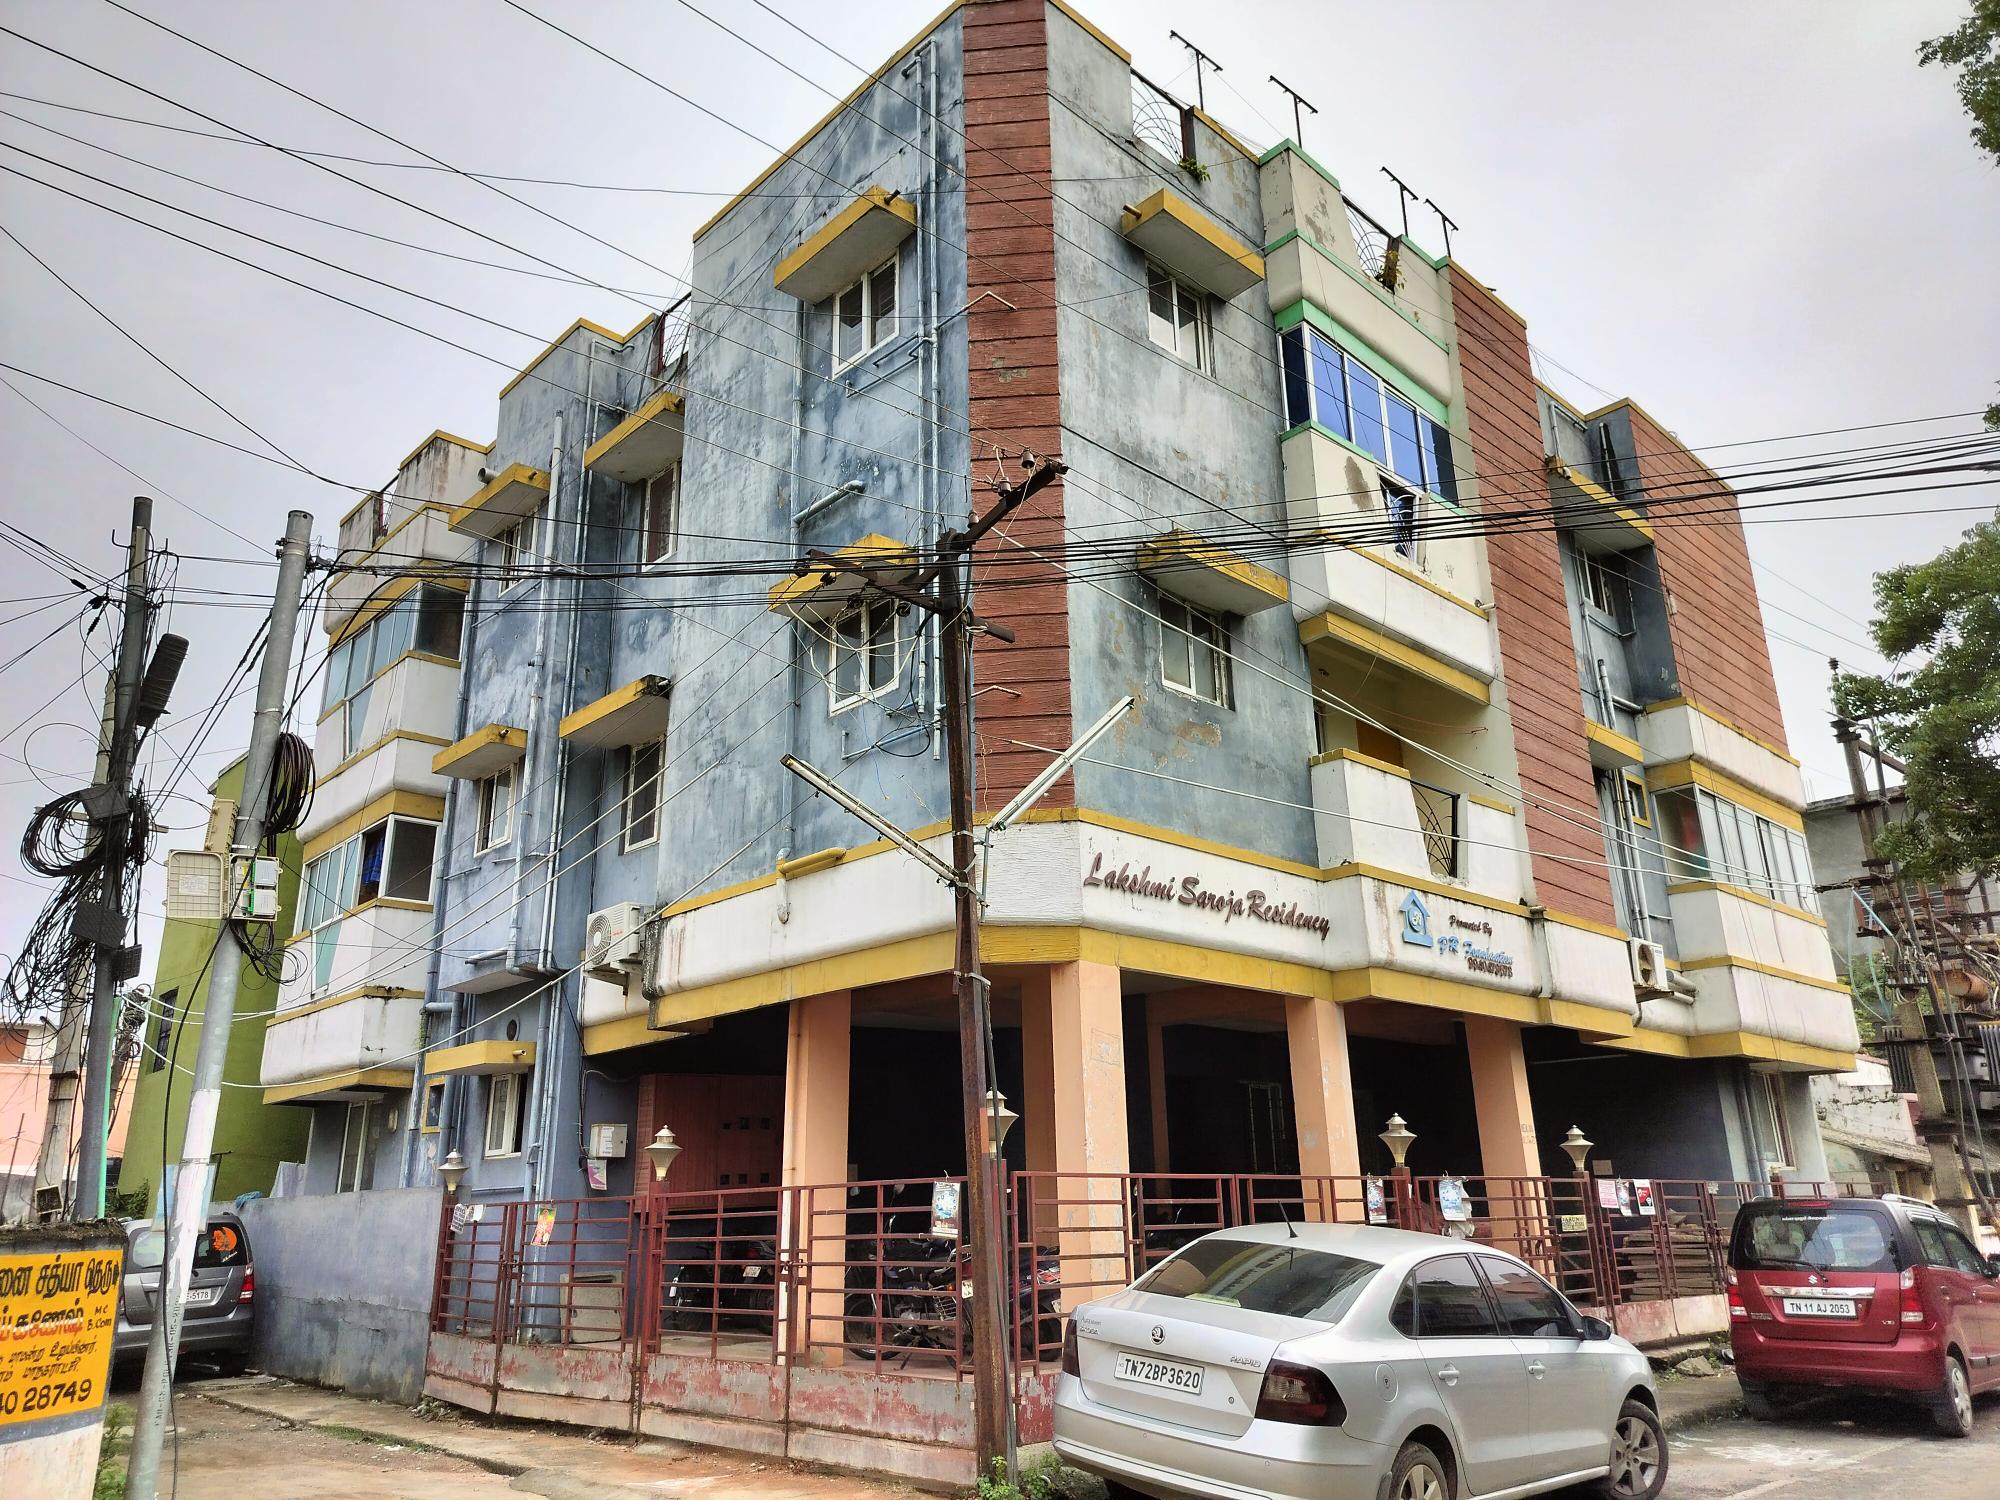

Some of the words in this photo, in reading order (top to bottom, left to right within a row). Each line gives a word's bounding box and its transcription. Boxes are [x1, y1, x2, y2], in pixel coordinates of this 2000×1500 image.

[1084, 852, 1175, 900] Lakshmi
[1178, 876, 1245, 924] Saroja
[1246, 889, 1330, 940] Residency
[1448, 915, 1481, 932] Promoted
[1482, 922, 1493, 936] By
[1438, 935, 1459, 954] PR
[36, 1254, 84, 1299] சத்யா
[85, 1257, 113, 1298] தெரு
[1790, 1303, 1802, 1312] TN
[1805, 1303, 1814, 1313] 11
[1816, 1303, 1827, 1313] AJ
[1830, 1304, 1850, 1314] 2053
[1124, 1357, 1200, 1389] TN72BP3620
[22, 1378, 92, 1412] 28749
